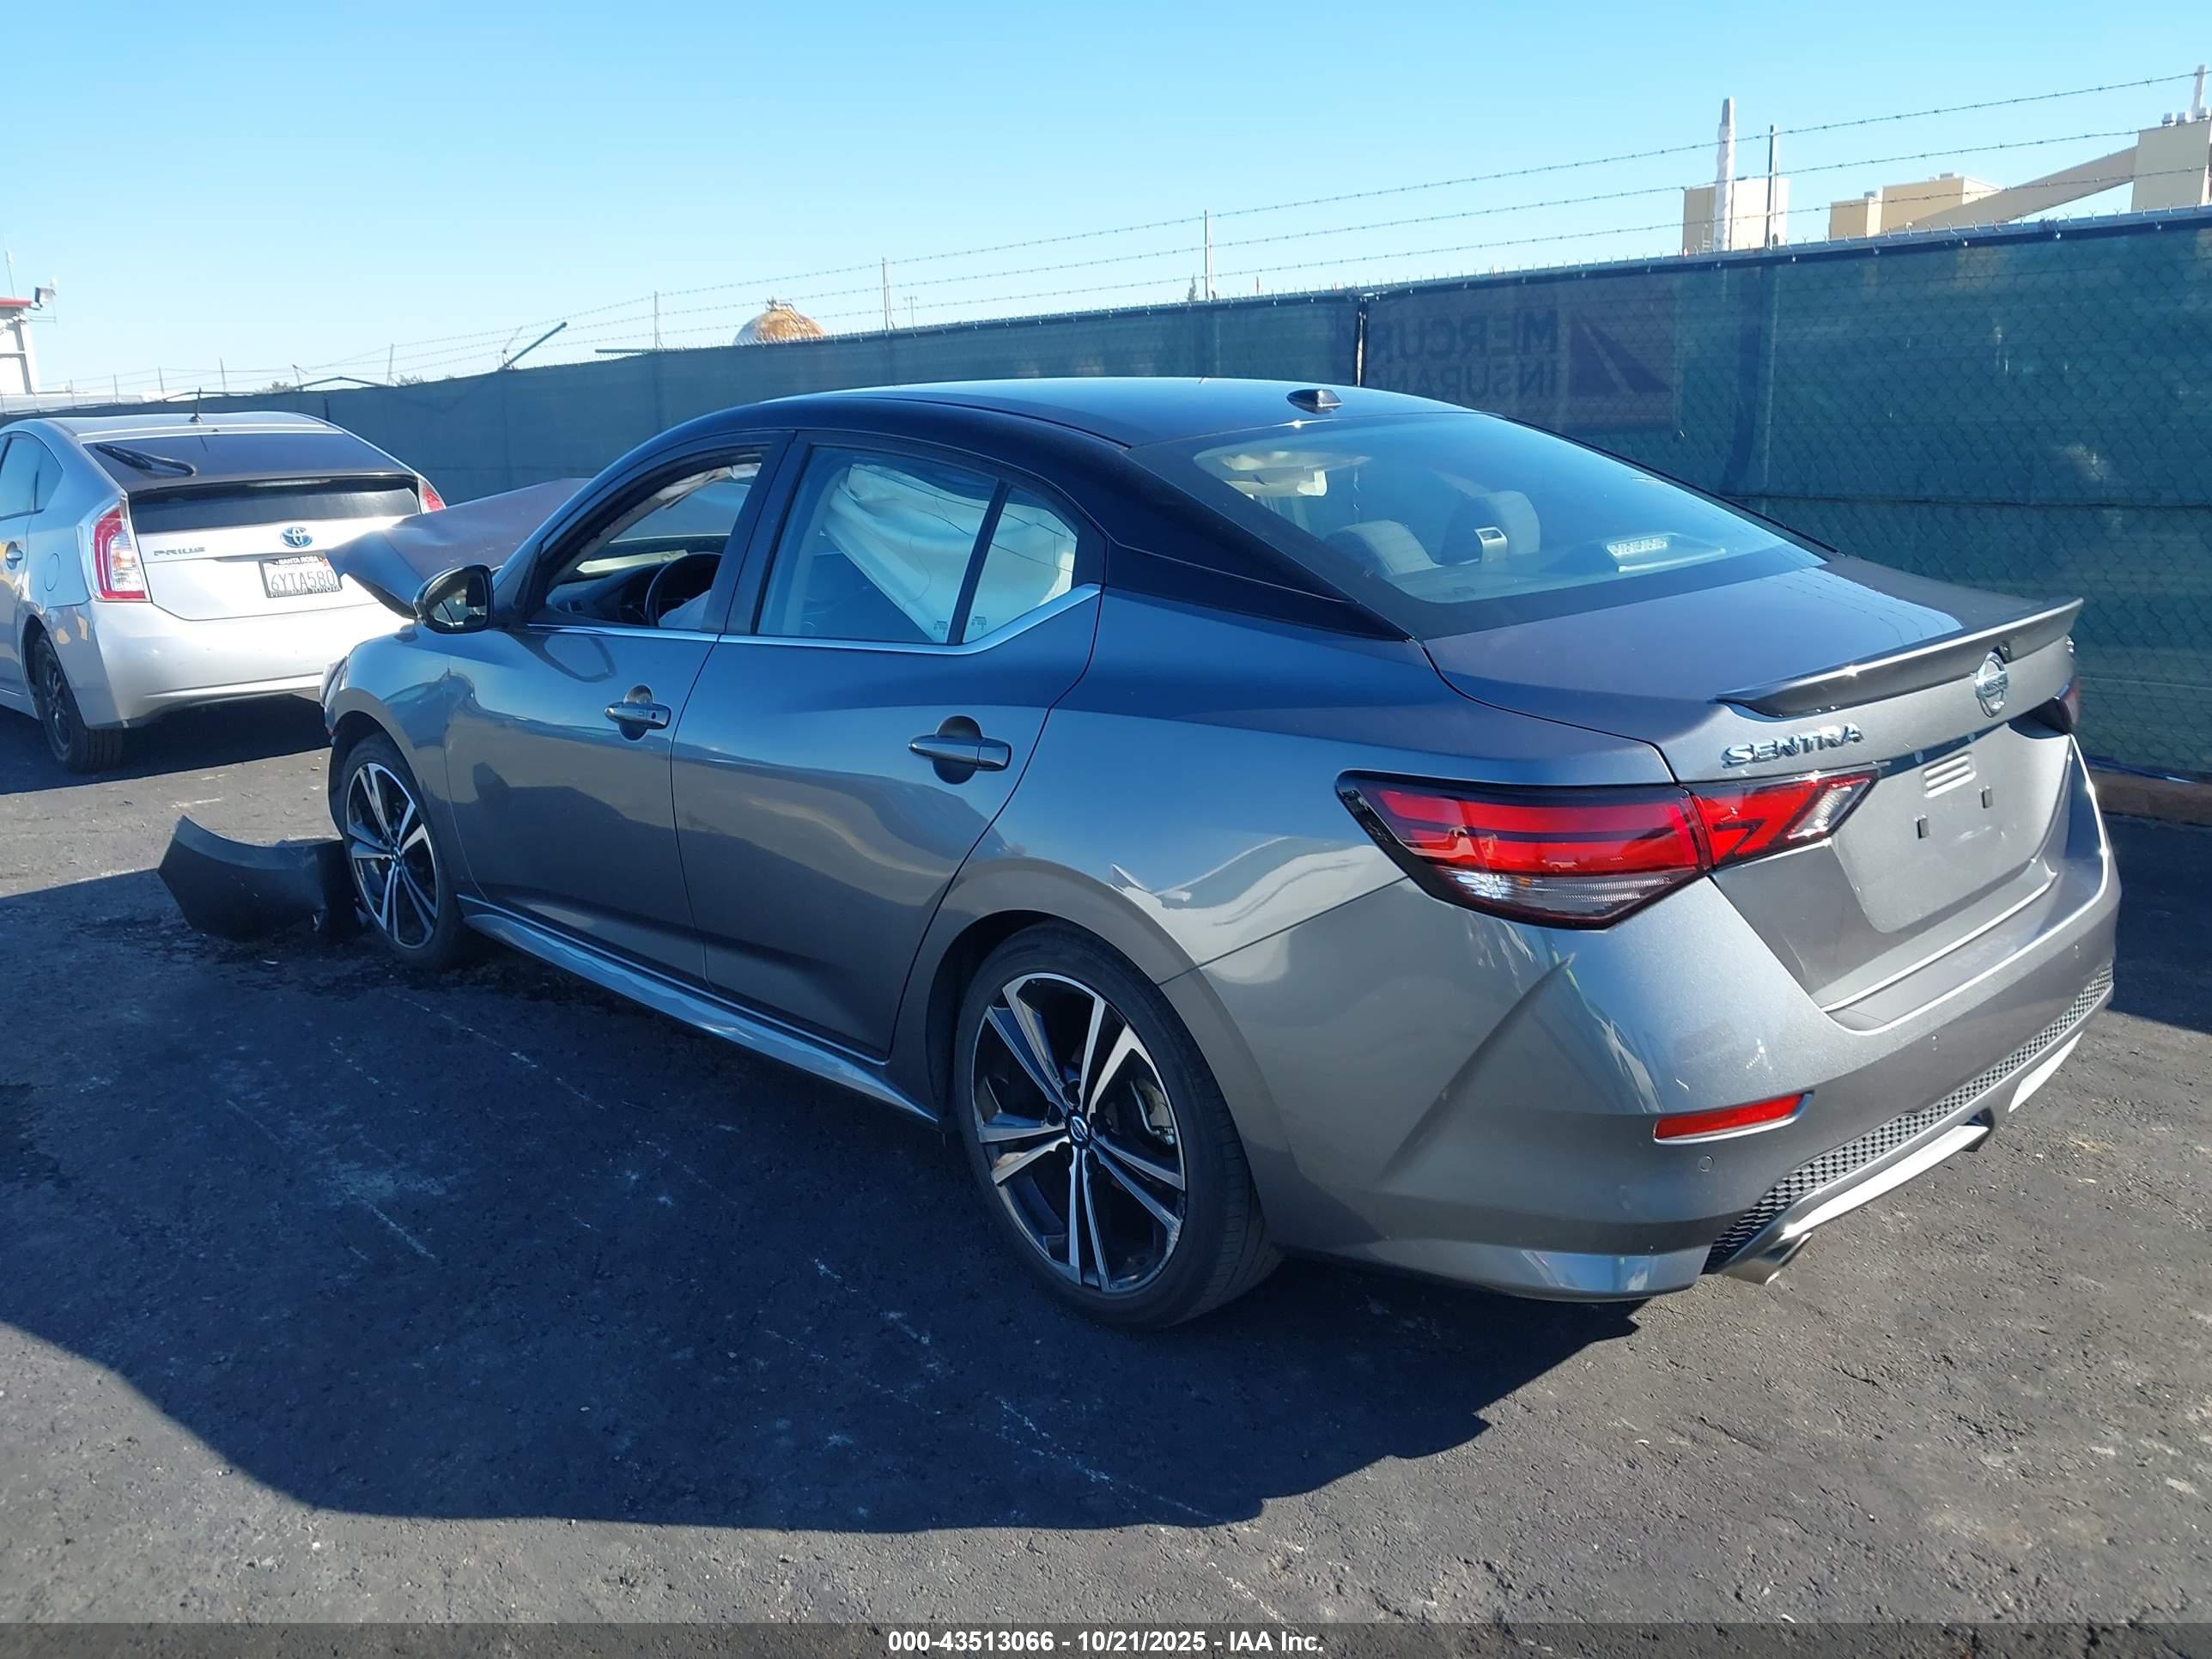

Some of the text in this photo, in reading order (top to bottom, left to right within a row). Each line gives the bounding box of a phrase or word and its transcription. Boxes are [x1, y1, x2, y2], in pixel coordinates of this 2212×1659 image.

[154, 547, 205, 556] PRIUS
[270, 569, 336, 592] 6YTA580
[1722, 722, 1865, 769] SENTRA
